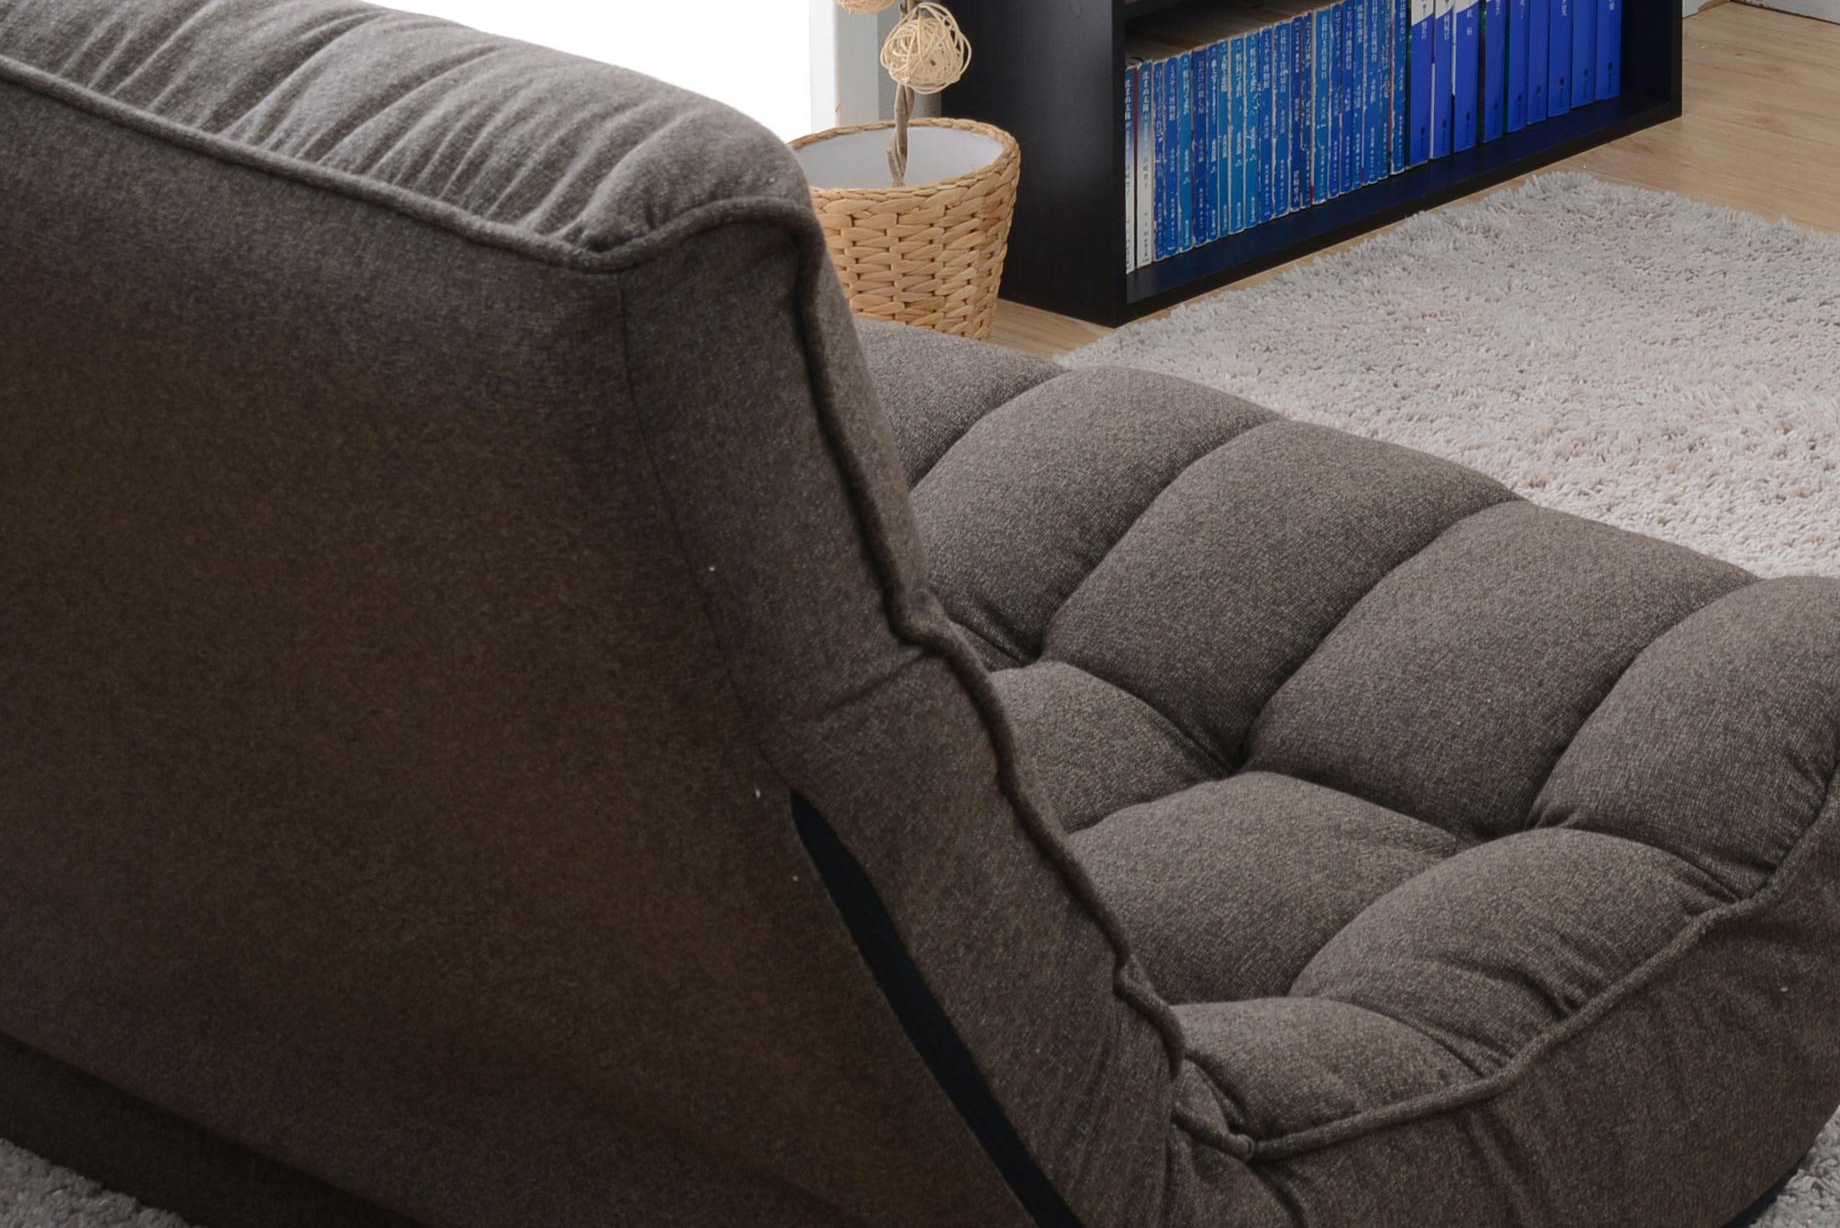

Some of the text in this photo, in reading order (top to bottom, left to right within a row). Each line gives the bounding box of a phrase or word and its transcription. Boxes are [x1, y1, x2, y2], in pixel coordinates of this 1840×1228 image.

[1168, 65, 1176, 121] ミステリ博物館
